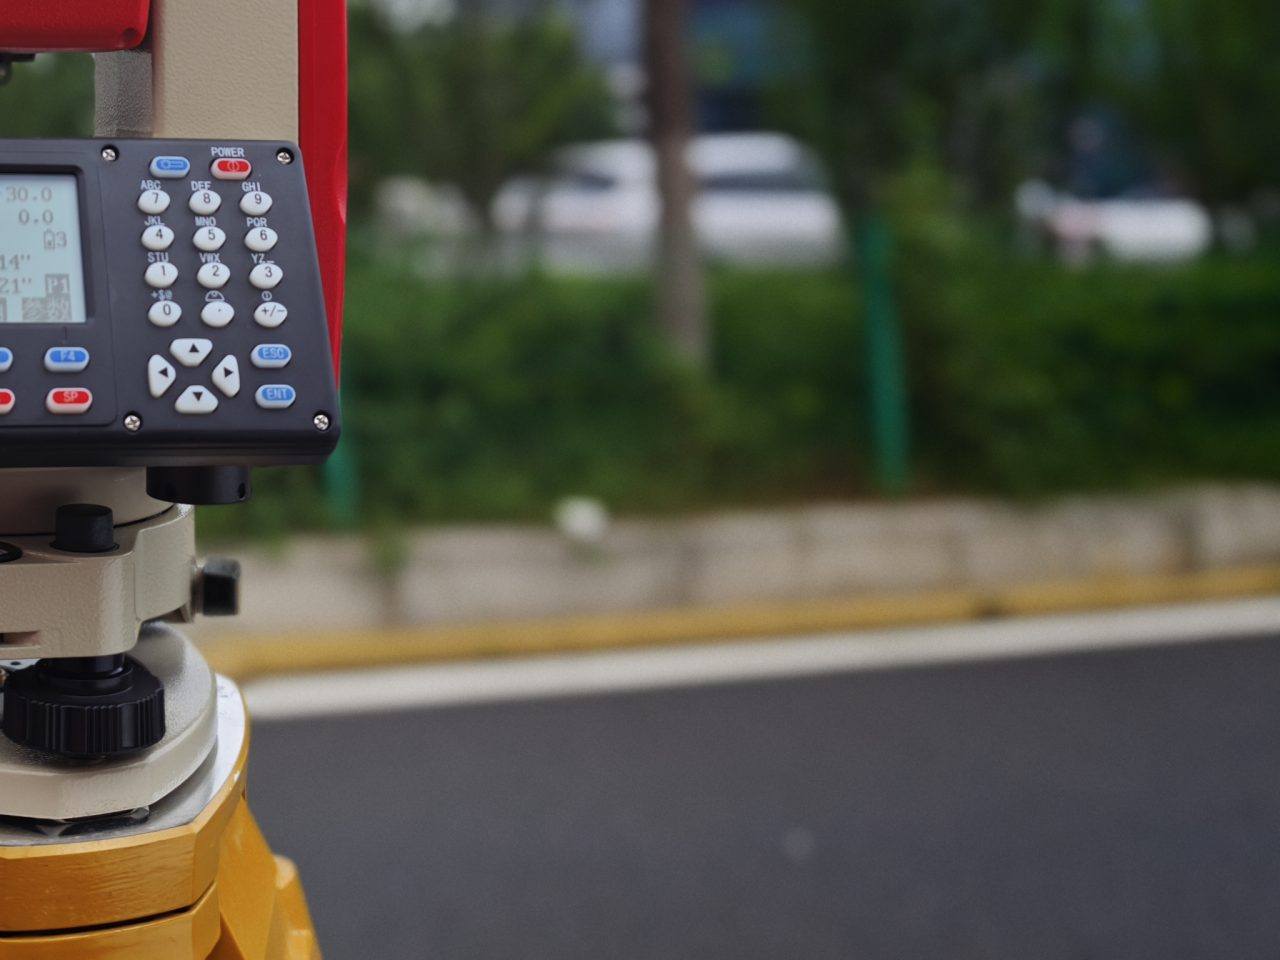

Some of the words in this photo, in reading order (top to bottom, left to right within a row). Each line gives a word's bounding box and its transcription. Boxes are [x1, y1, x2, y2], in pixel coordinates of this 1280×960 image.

[211, 147, 245, 157] POWER
[140, 180, 162, 190] ABC
[191, 181, 211, 191] DEF
[241, 182, 261, 191] GHI
[152, 192, 159, 204] 7
[203, 192, 211, 204] 8
[254, 193, 262, 205] 9
[18, 209, 54, 225] 0.0
[144, 216, 165, 226] JKL
[195, 216, 216, 227] MNO
[246, 217, 268, 227] PQR
[156, 228, 163, 240] 4
[208, 229, 216, 240] 5
[260, 229, 268, 240] 6
[147, 252, 169, 262] STU
[199, 253, 221, 263] VWX
[160, 265, 166, 277] 1
[211, 265, 220, 277] 2
[265, 266, 273, 278] 3
[47, 276, 69, 295] P1
[163, 303, 171, 316] 0
[60, 350, 76, 361] F4
[263, 347, 285, 359] ESC
[63, 391, 78, 402] SP
[267, 388, 289, 401] ENT
